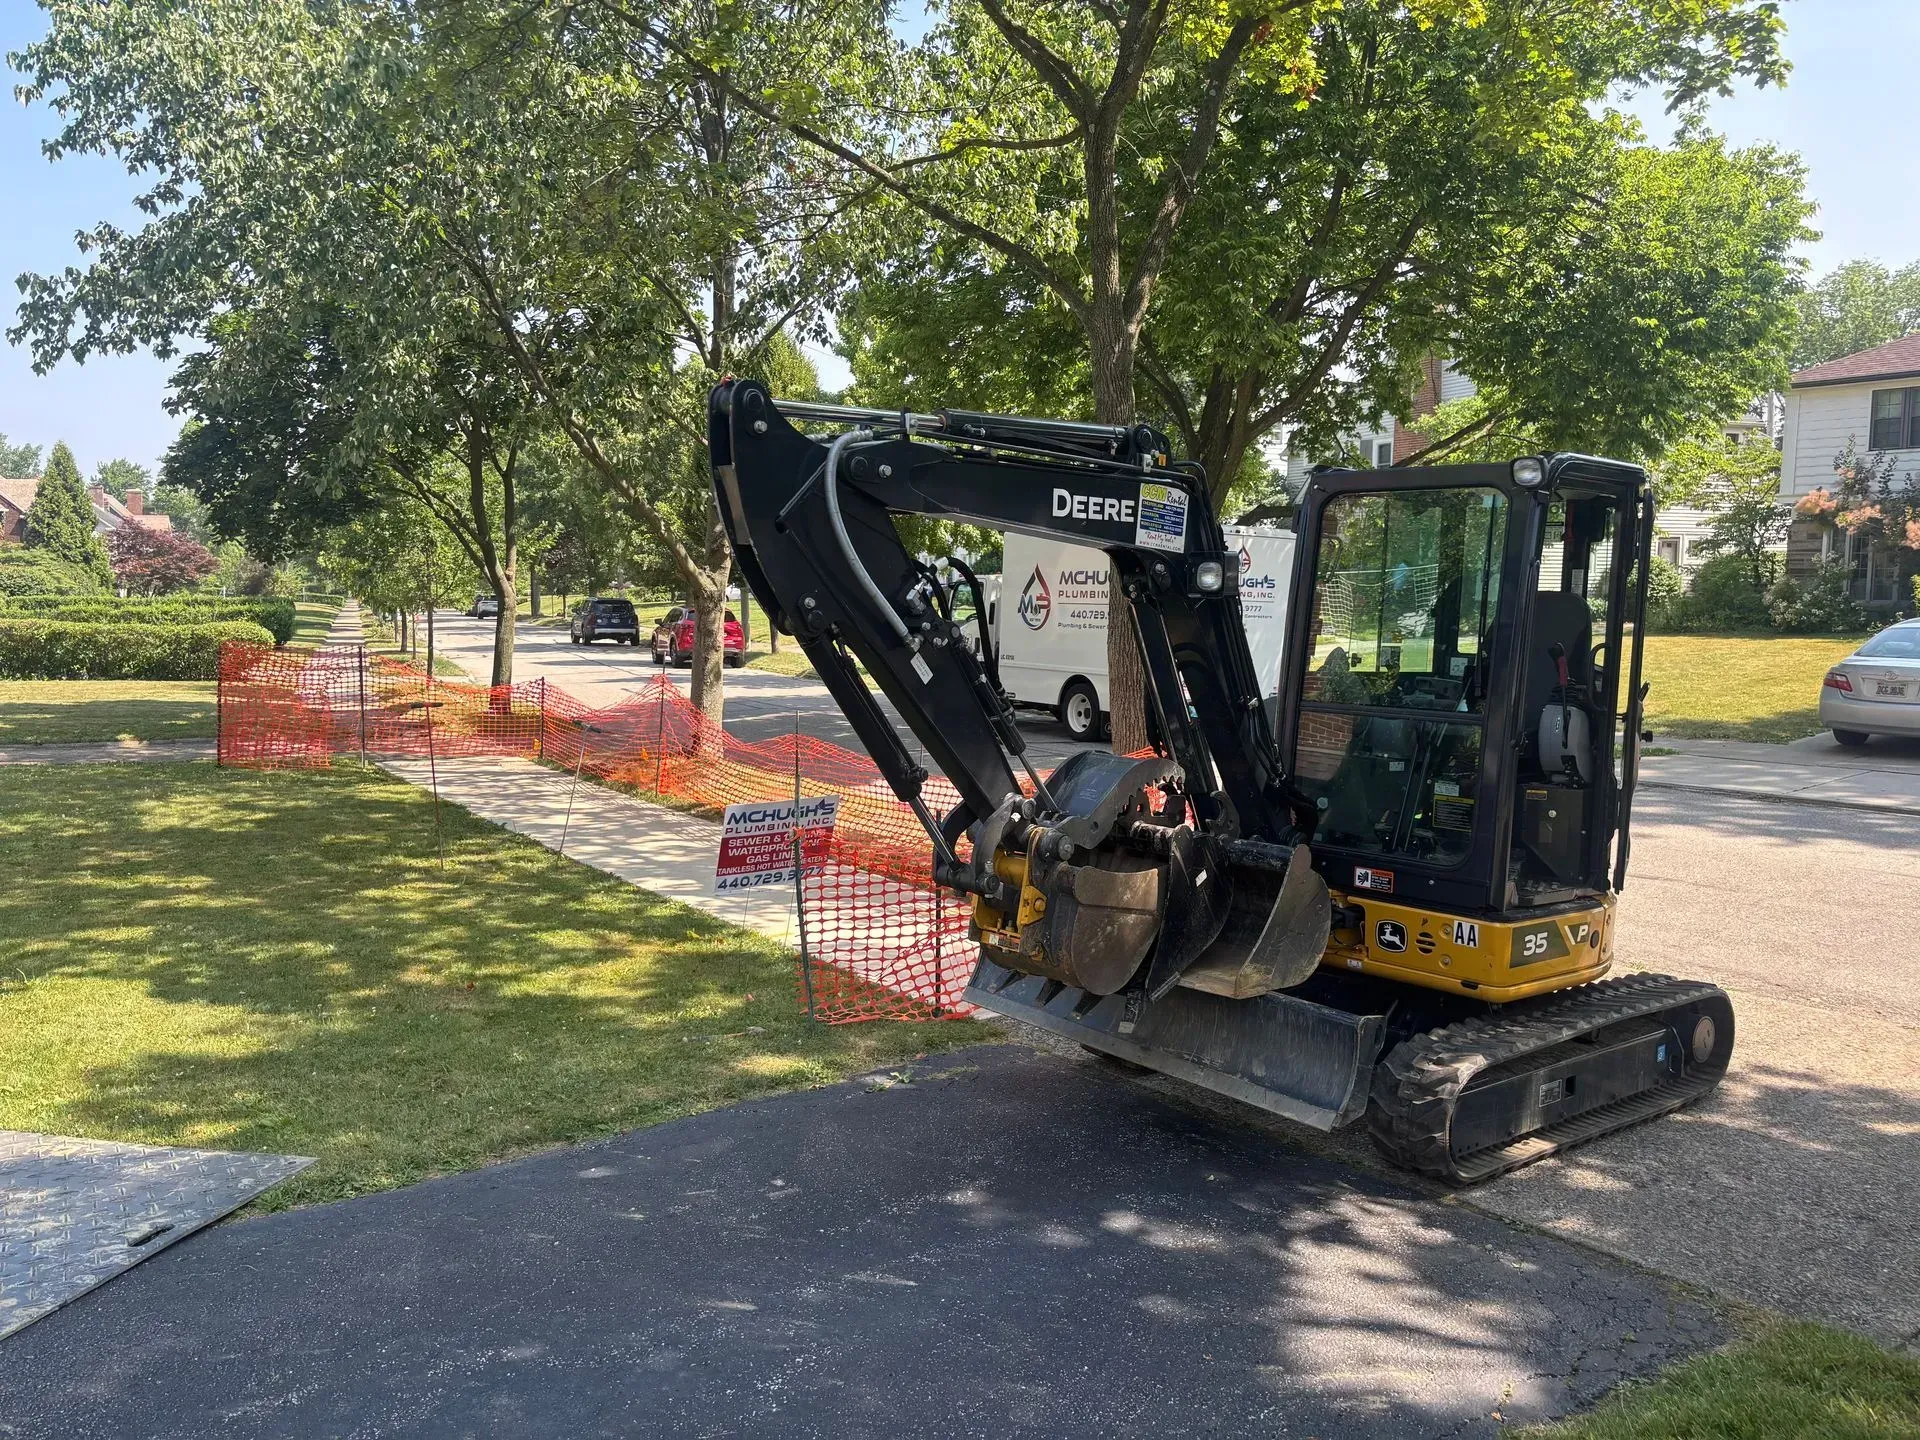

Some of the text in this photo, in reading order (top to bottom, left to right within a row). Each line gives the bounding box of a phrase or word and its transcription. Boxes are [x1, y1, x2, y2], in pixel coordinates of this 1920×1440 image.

[1141, 483, 1188, 507] CCM Rental
[1052, 488, 1135, 522] DEERE
[1059, 570, 1109, 586] MCHU
[1058, 590, 1109, 599] PLUMBIN
[1070, 609, 1109, 620] 440.729.
[1058, 622, 1082, 630] Plumbing
[728, 835, 771, 847] SEWER
[773, 834, 783, 843] &
[746, 855, 770, 864] GAS
[718, 865, 756, 875] TANKLESS
[756, 862, 772, 871] HOT
[1454, 922, 1478, 948] AA
[1523, 924, 1589, 957] 35 P
